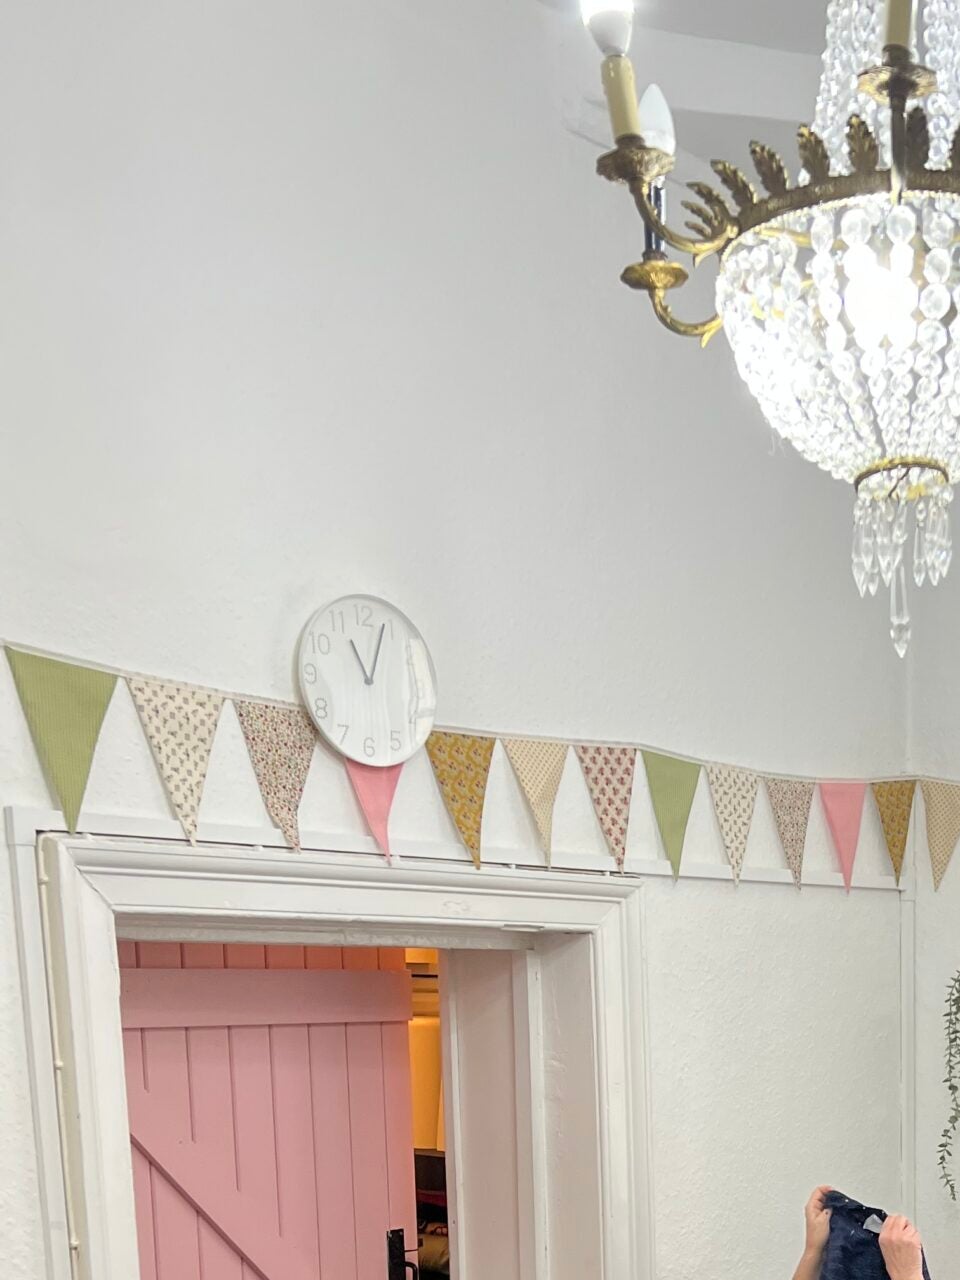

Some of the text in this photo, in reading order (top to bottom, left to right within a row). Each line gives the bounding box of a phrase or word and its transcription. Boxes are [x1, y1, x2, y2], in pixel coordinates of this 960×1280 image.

[329, 610, 345, 634] 11
[353, 604, 374, 627] 12
[387, 619, 394, 640] 1
[308, 631, 331, 655] 10
[303, 663, 317, 684] 9
[314, 697, 328, 719] 8
[337, 724, 350, 745] 7
[390, 730, 402, 751] 5
[363, 737, 376, 758] 6
